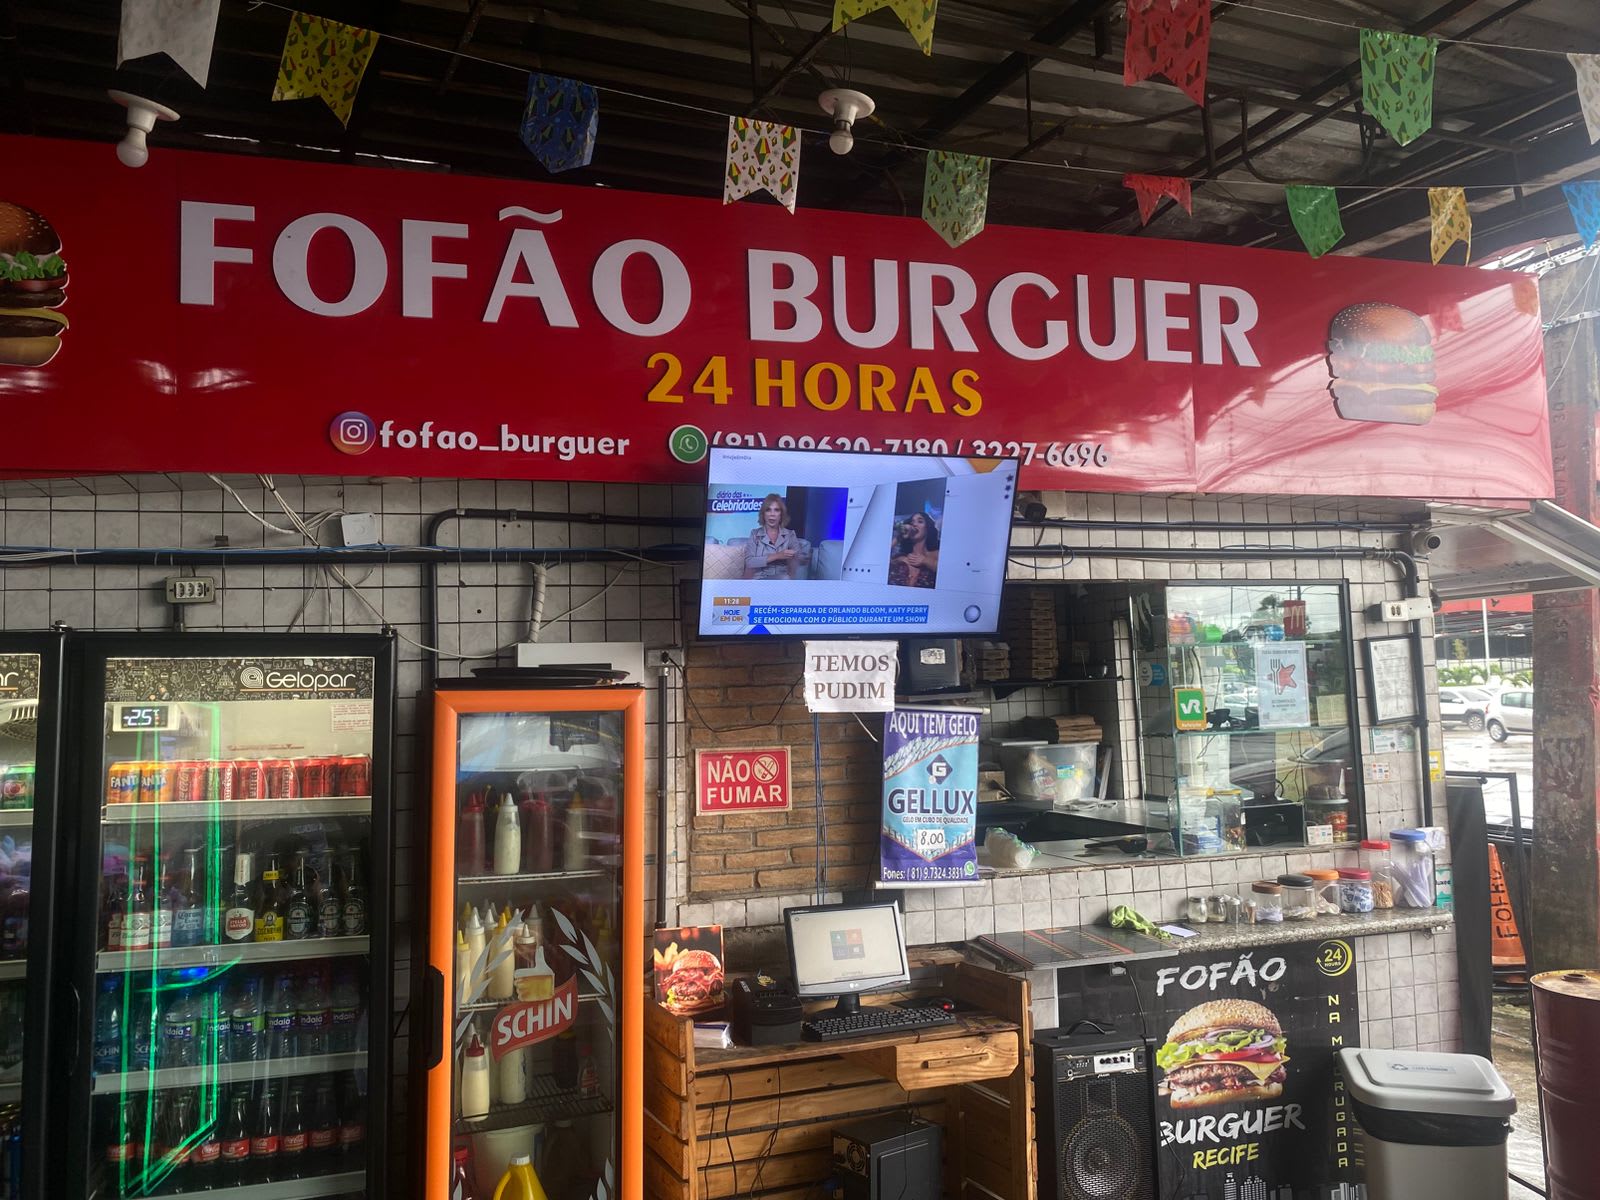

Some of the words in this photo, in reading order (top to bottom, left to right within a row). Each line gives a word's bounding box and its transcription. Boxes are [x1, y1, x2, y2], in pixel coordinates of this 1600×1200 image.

[180, 200, 691, 337] FOFÃO
[747, 248, 1262, 368] BURGUER
[647, 352, 733, 405] 24
[755, 358, 984, 417] HORAS
[379, 419, 630, 460] fofao_burguer
[711, 499, 763, 512] Celebridades
[753, 606, 817, 614] RECÉM-SEPARADA
[862, 606, 887, 615] BLOOM,
[888, 606, 906, 614] KATY
[906, 606, 928, 614] PERRY
[753, 616, 763, 624] SE
[764, 616, 802, 624] EMOCIONA
[828, 615, 858, 623] PÚBLICO
[811, 654, 890, 673] TEMOS
[266, 670, 356, 692] Gelopar
[814, 682, 886, 700] PUDIM
[889, 712, 920, 740] AQUI
[922, 713, 946, 736] TEM
[949, 716, 977, 736] GELO
[706, 754, 751, 784] NÃO
[111, 774, 138, 788] FANT
[141, 774, 166, 787] ANTA
[706, 785, 783, 805] FUMAR
[888, 788, 975, 815] GELLUX
[883, 866, 906, 880] Fones:
[1324, 948, 1342, 962] 24
[1156, 952, 1288, 997] FOFÃO
[496, 992, 574, 1047] SCHIN
[135, 1044, 159, 1055] SCHN
[1160, 1103, 1306, 1147] BURGUER
[1193, 1143, 1260, 1169] RECIFE
